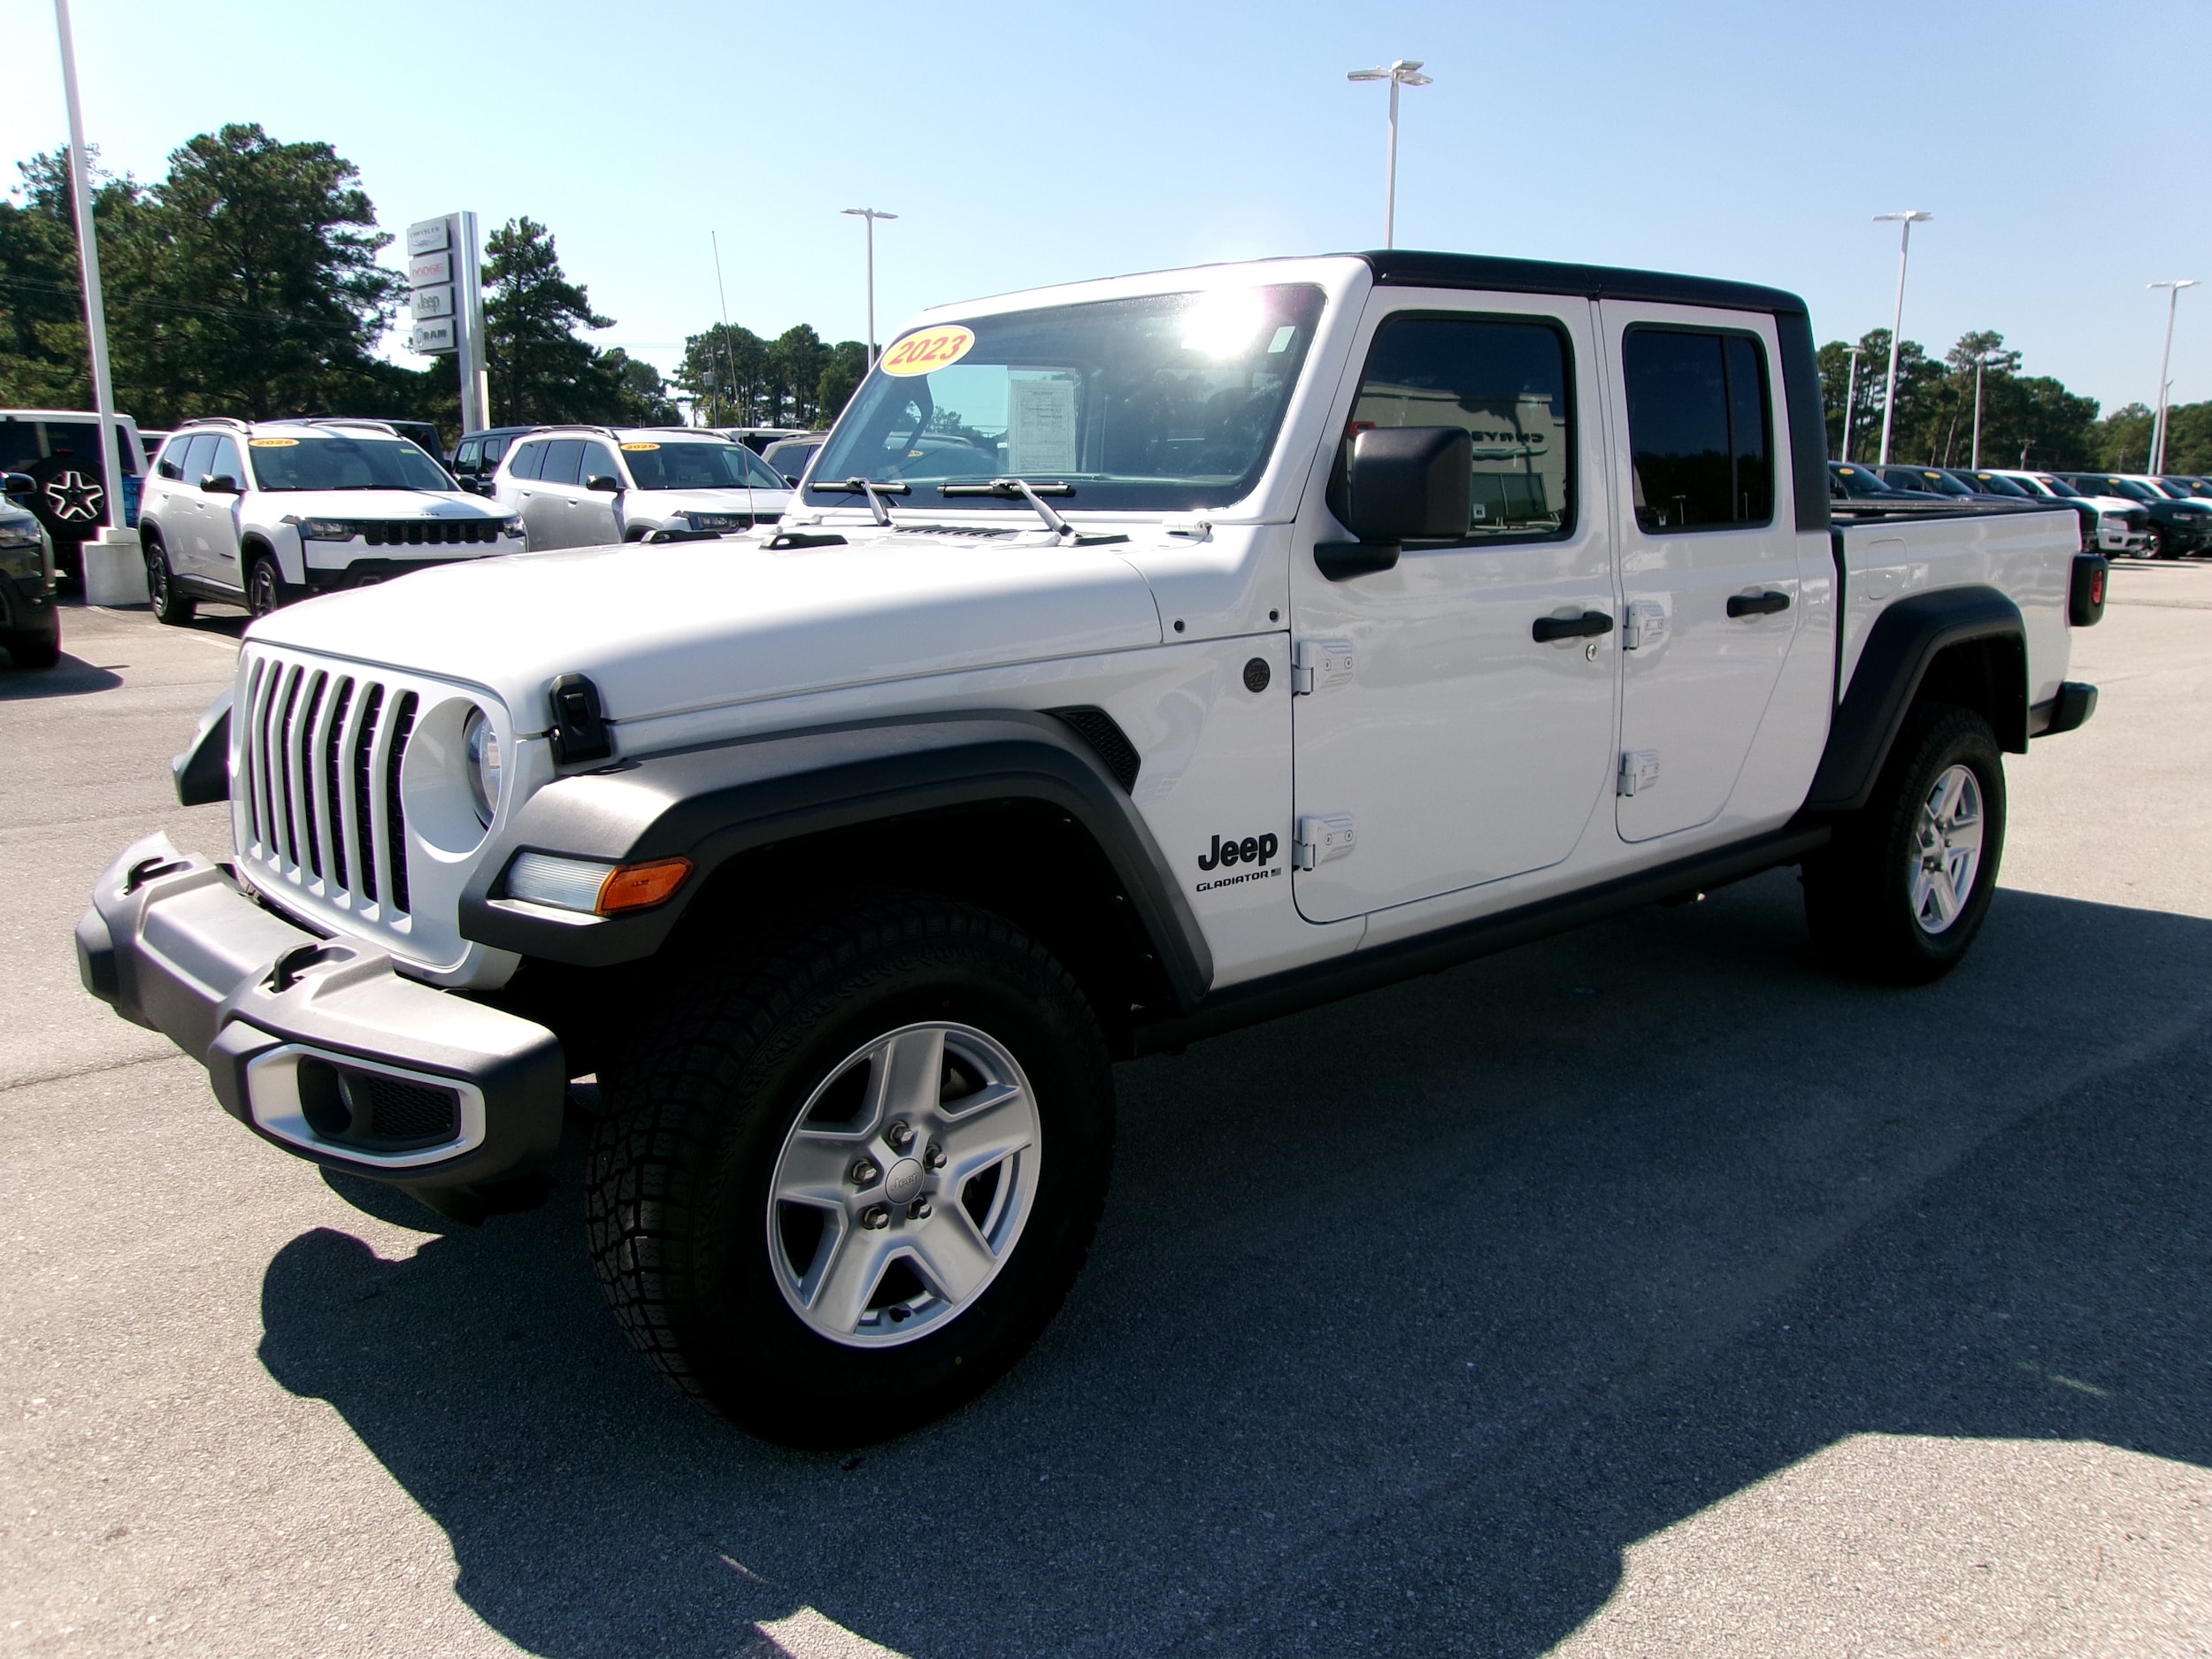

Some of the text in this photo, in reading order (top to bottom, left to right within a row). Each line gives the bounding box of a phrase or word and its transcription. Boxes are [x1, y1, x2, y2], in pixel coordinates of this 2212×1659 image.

[410, 226, 440, 238] CHRYSLER
[411, 263, 444, 279] DODGE
[417, 293, 441, 313] Jeep
[423, 328, 447, 342] RAM
[887, 334, 967, 366] 2023
[1197, 833, 1279, 872] Jeep
[1195, 871, 1270, 892] GLADIATOR
